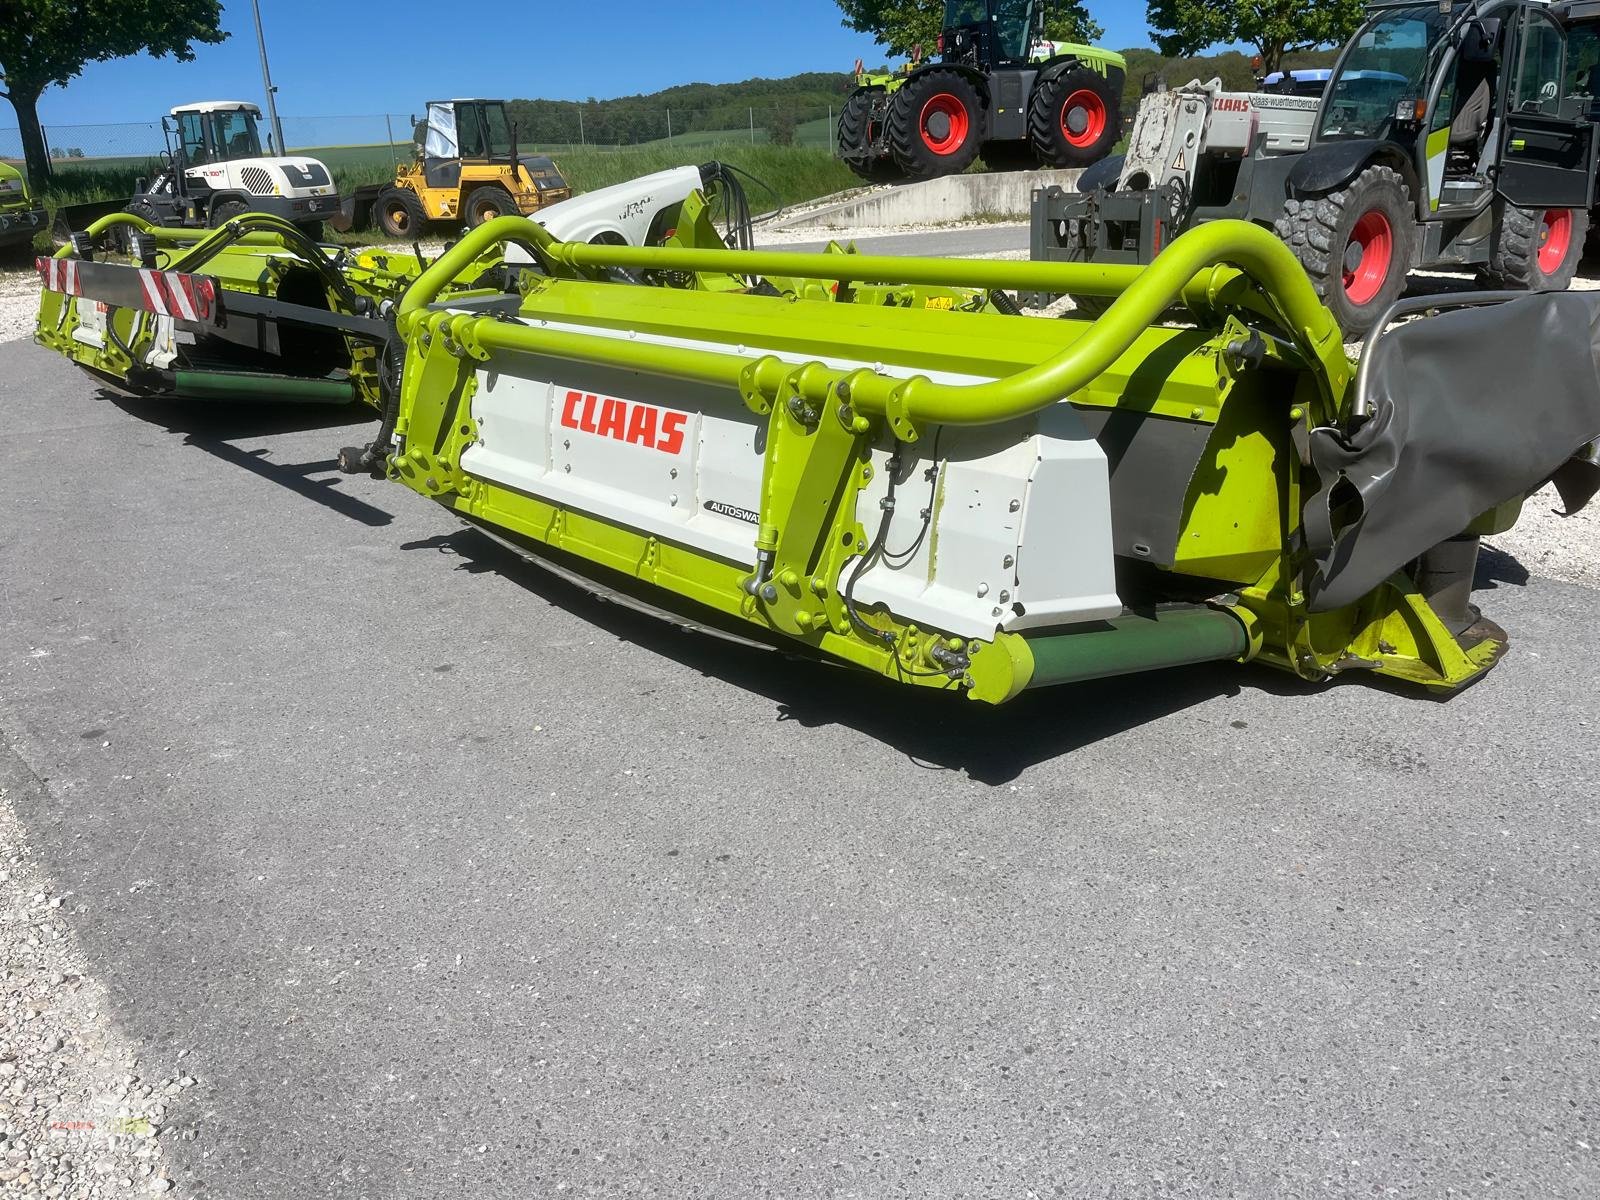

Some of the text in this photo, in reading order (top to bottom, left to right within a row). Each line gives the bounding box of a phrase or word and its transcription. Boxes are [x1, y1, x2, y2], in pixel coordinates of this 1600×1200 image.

[1213, 98, 1249, 112] CLAAS
[148, 174, 166, 195] TEREX
[560, 391, 688, 455] CLAAS
